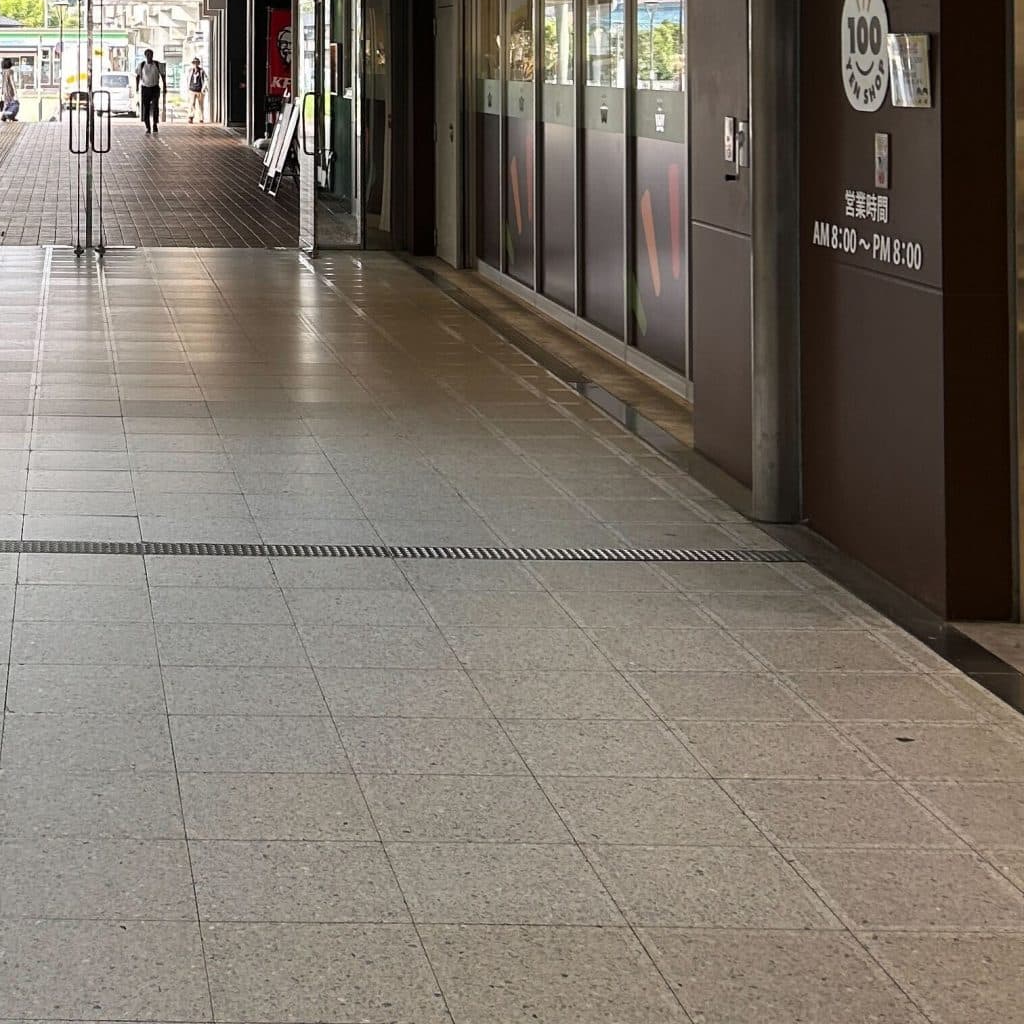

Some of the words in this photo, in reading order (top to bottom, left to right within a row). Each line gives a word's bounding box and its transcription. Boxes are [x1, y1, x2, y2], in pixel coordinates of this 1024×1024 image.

[847, 16, 882, 55] 100
[271, 77, 292, 88] KF
[846, 57, 861, 99] YEN
[864, 59, 885, 104] SHOP
[845, 189, 888, 223] 営業時間
